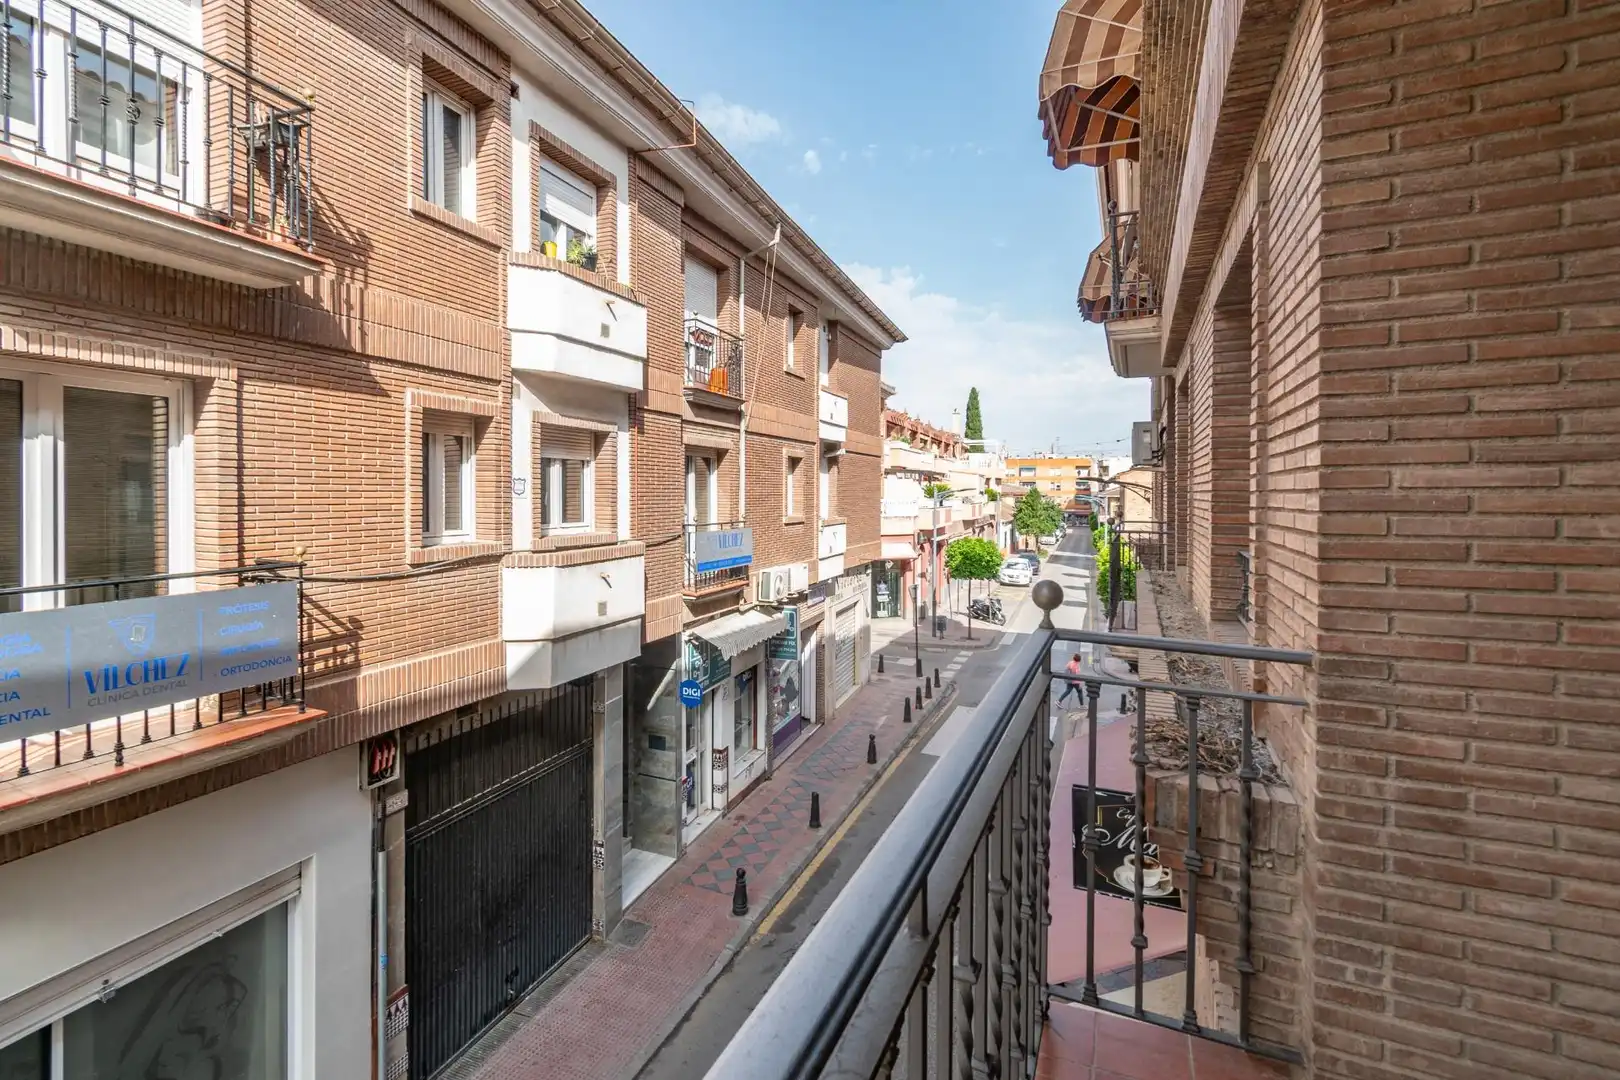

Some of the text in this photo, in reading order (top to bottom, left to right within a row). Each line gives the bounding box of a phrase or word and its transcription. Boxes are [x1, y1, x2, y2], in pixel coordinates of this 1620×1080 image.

[83, 652, 190, 695] VILCHEZ
[220, 655, 293, 677] ORTODONCIA
[682, 687, 701, 698] DIGI
